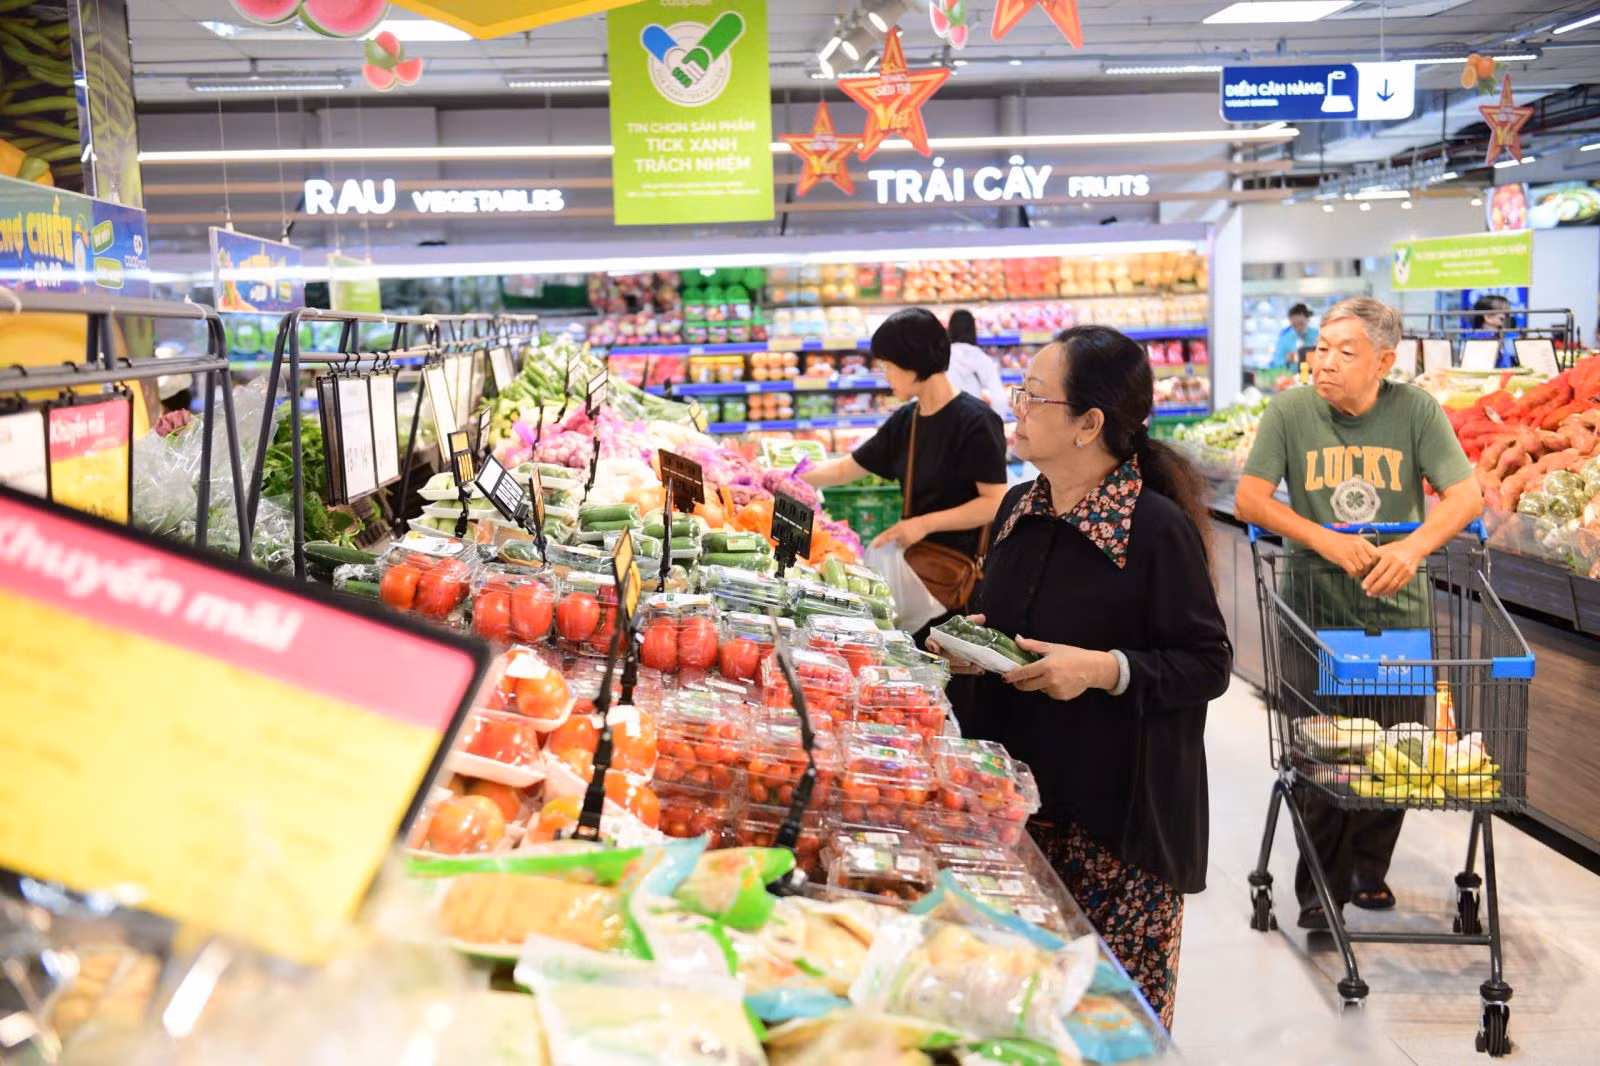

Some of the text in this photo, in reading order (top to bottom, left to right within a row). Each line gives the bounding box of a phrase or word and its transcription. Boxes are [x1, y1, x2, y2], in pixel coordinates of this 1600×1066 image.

[645, 137, 738, 152] TICK XANH
[634, 153, 751, 174] TRÁCH NHIỆM
[868, 157, 965, 203] TRÁI
[973, 155, 1052, 201] CÂY
[1068, 174, 1150, 198] FRUITS
[304, 179, 396, 214] RAU
[411, 189, 564, 213] VEGETABLES
[1305, 445, 1403, 491] LUCKY
